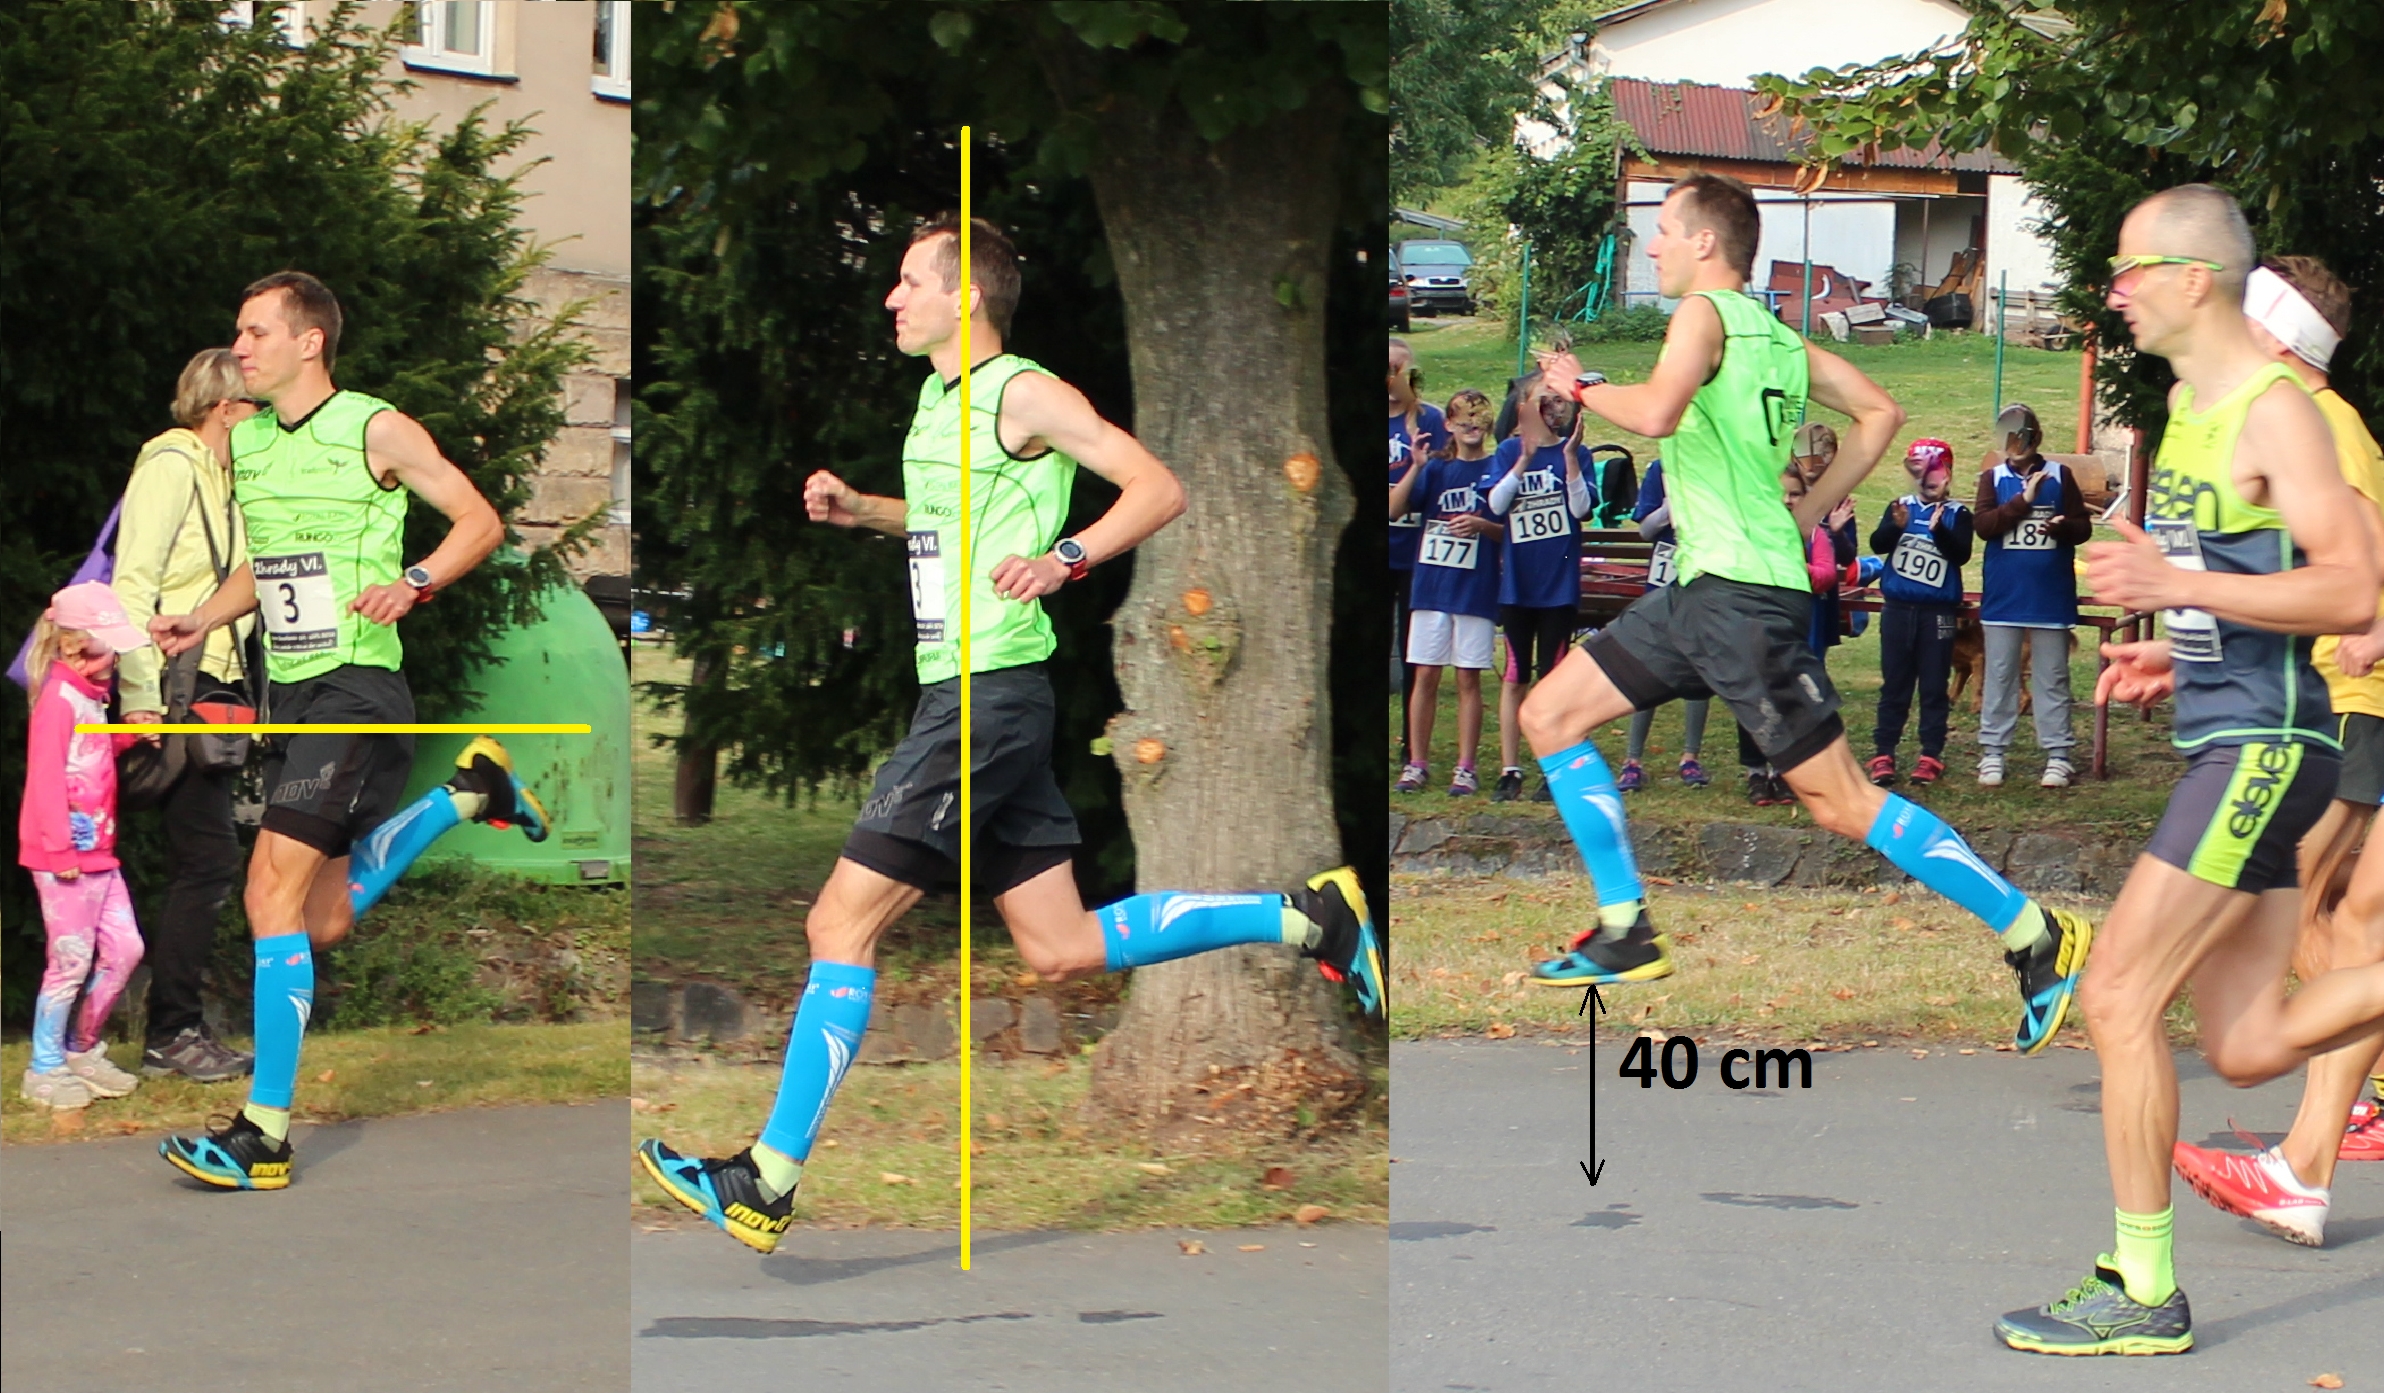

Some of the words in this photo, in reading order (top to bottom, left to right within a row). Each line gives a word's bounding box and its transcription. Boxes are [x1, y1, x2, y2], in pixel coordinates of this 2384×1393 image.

[1516, 510, 1563, 539] 180
[1425, 537, 1472, 565] 177
[1896, 550, 1942, 582] 190
[278, 582, 299, 624] 3
